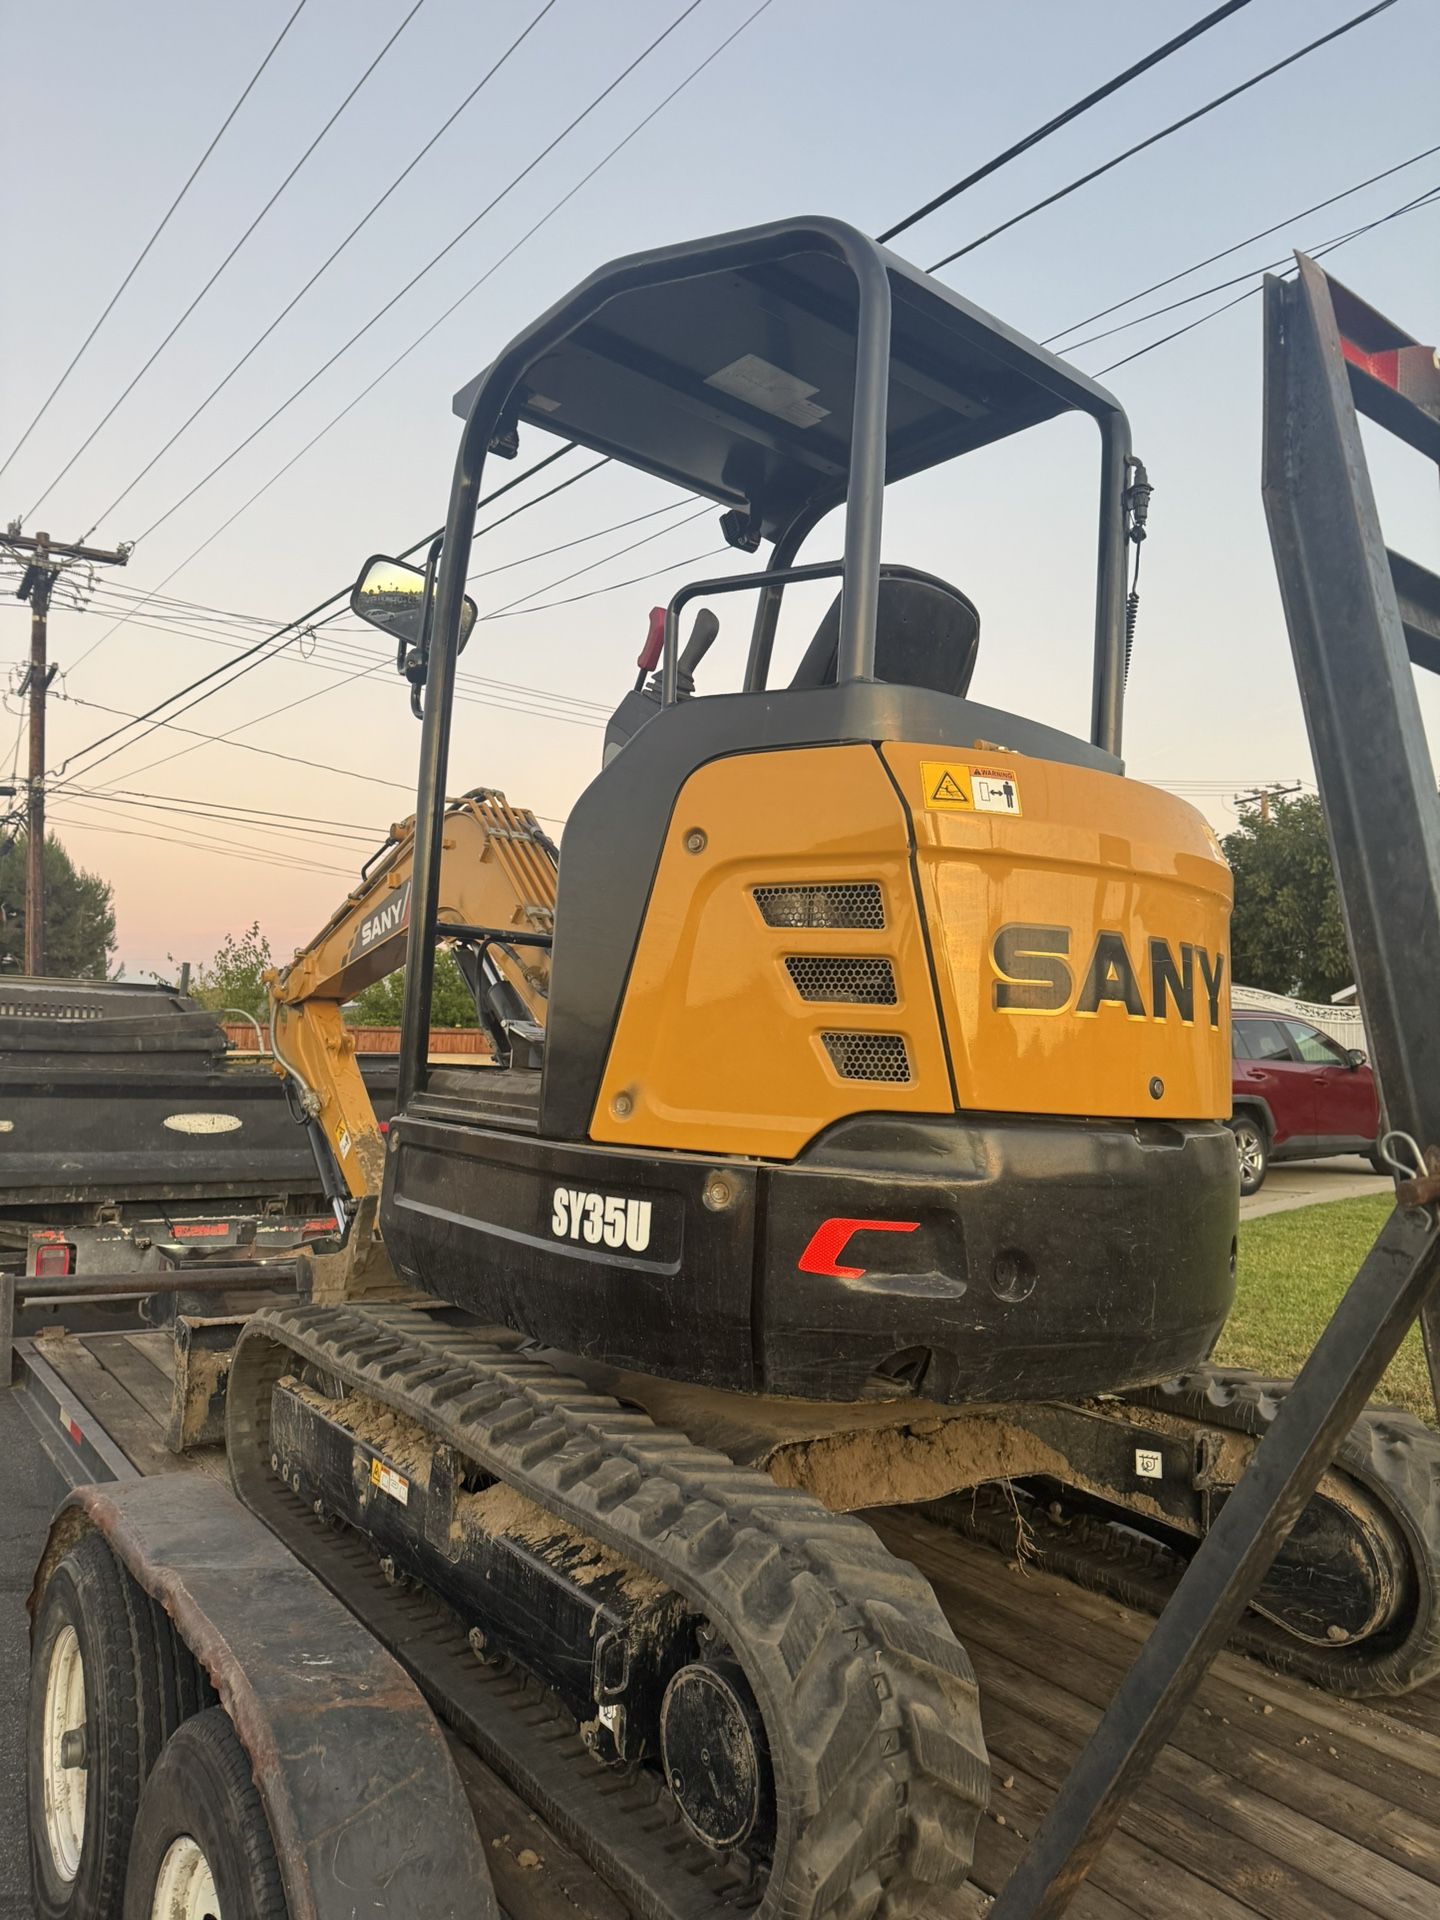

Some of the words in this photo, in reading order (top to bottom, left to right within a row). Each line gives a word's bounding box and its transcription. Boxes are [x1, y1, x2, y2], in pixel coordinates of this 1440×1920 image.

[981, 769, 1013, 779] WARNING
[362, 899, 402, 946] SANY
[992, 923, 1224, 1030] SANY
[551, 1187, 652, 1252] SY35U
